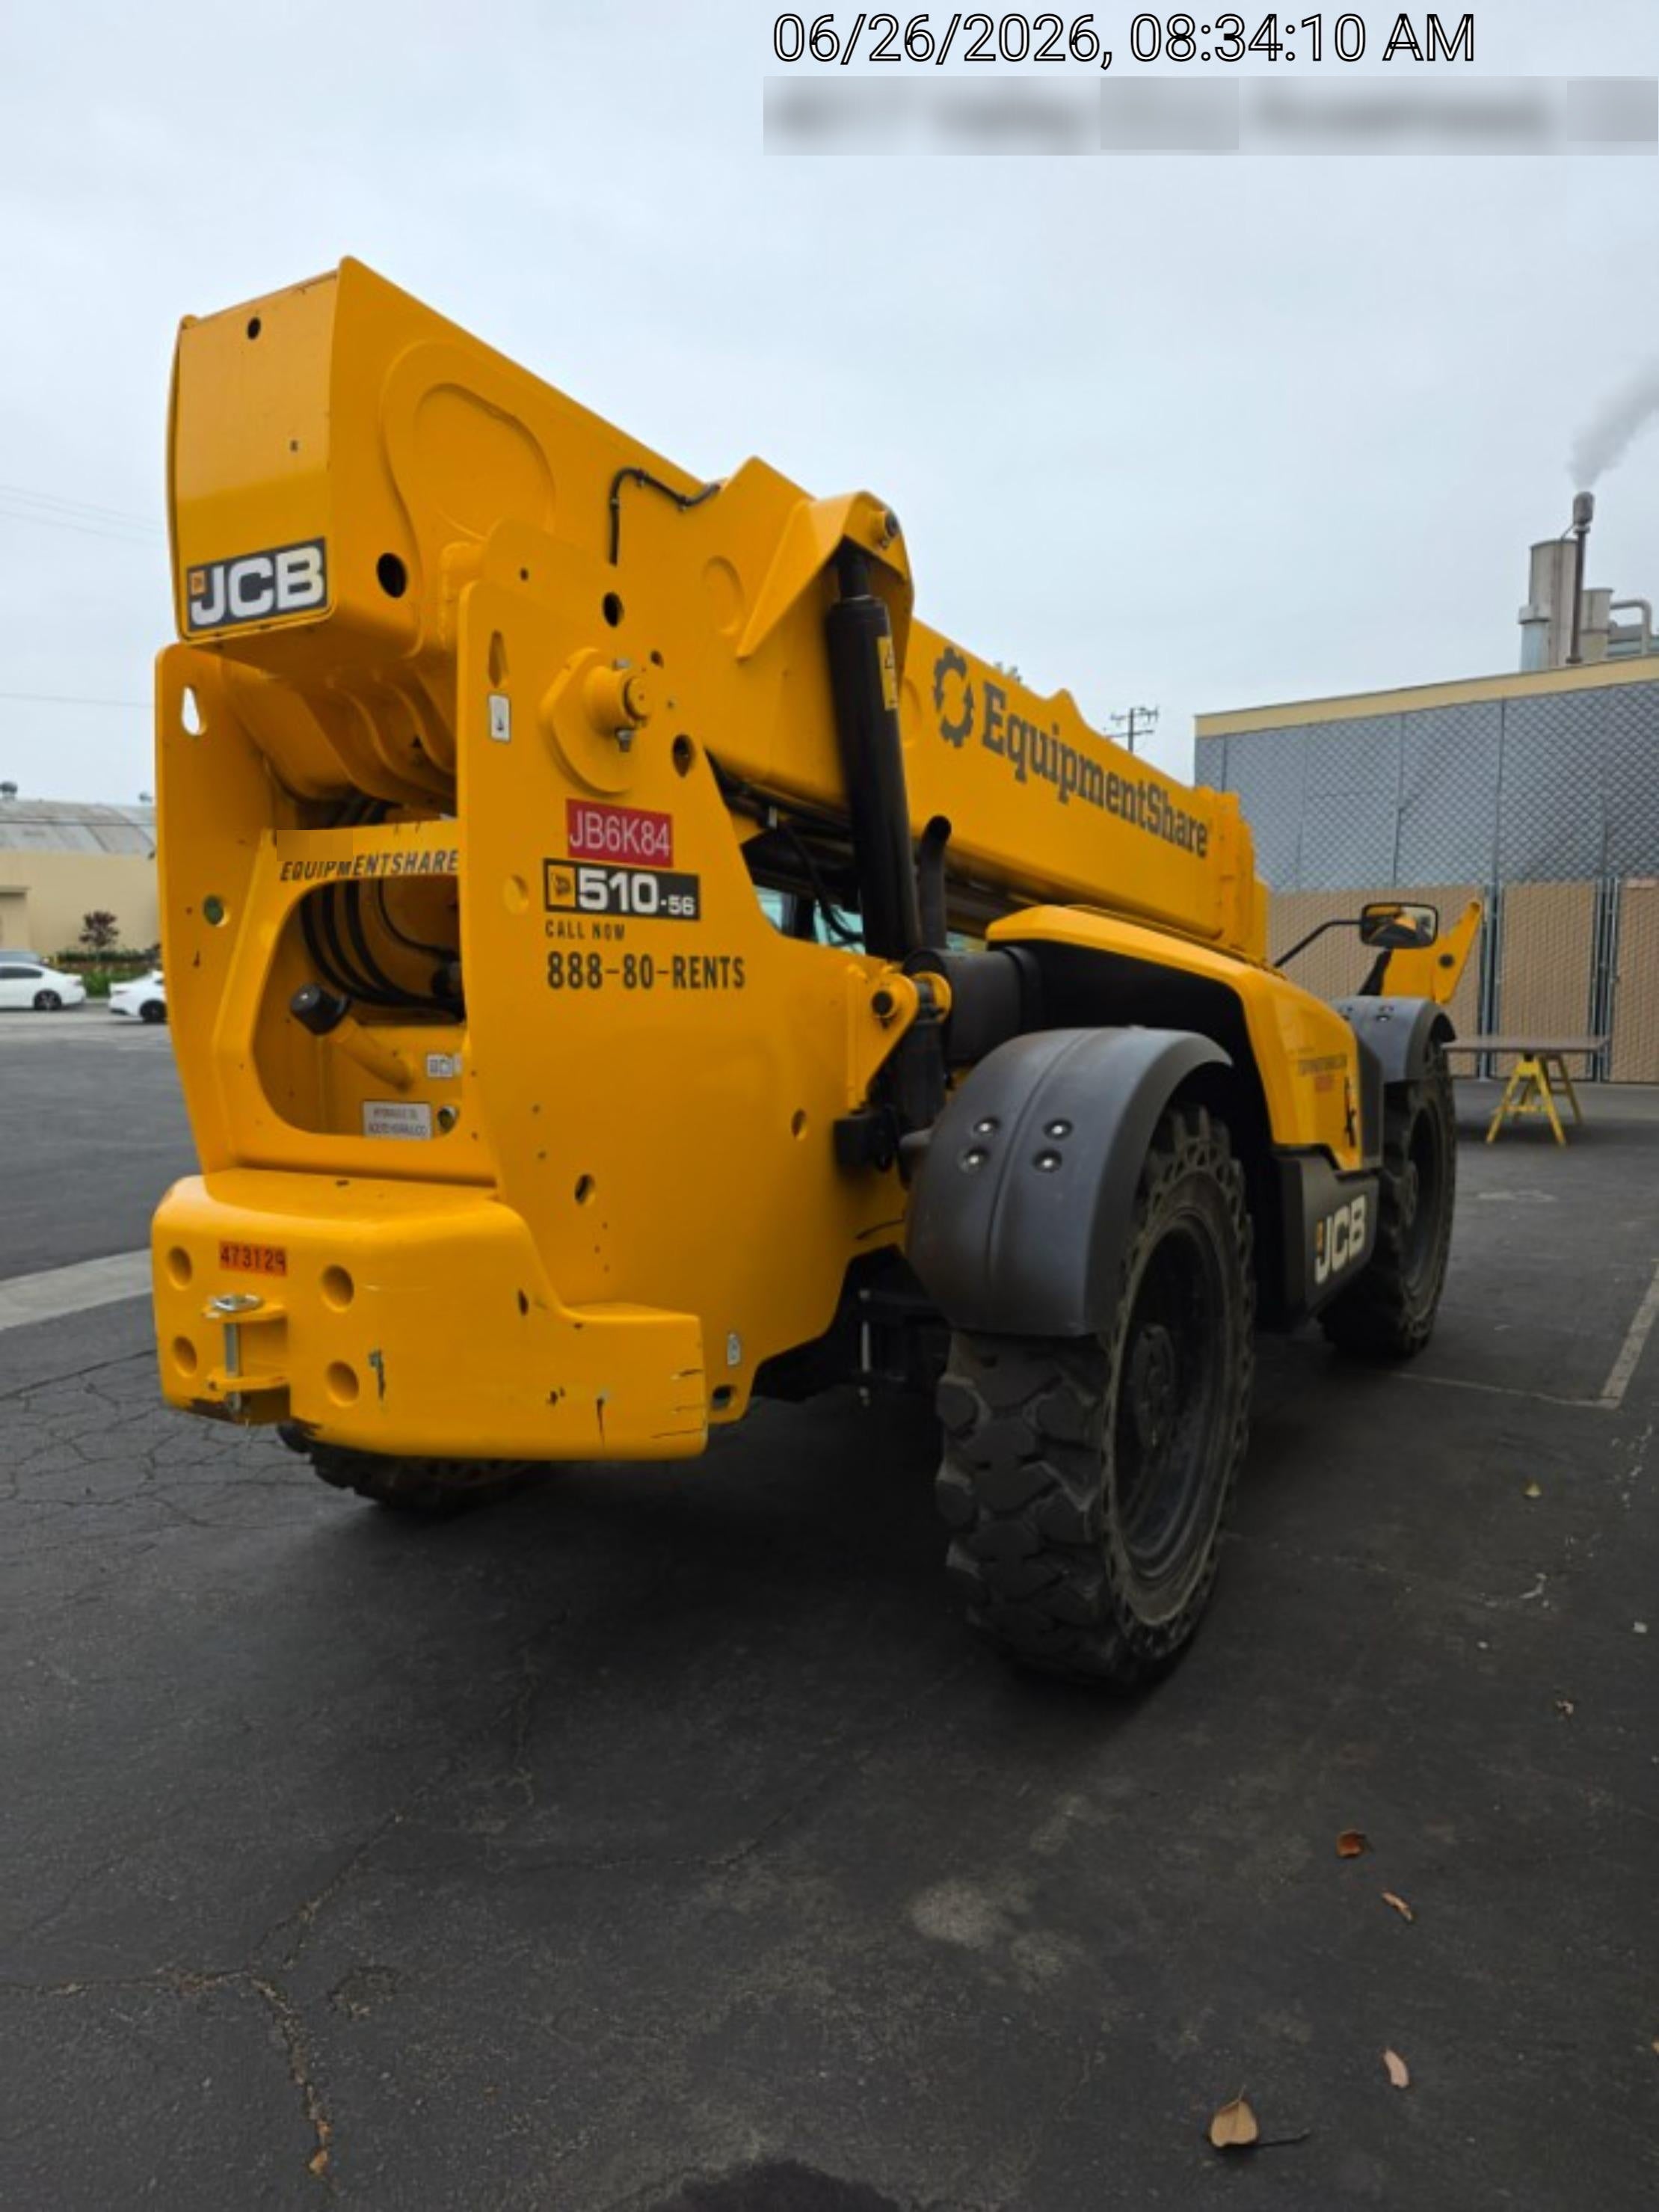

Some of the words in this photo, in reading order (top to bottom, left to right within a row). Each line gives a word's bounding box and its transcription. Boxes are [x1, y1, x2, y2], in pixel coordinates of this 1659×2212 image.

[189, 545, 325, 626] JCB
[981, 679, 1208, 859] EquipmentShare
[569, 809, 671, 858] JB6K84
[279, 849, 459, 882] EQUIPMENTSHARE
[545, 918, 585, 939] CALL
[591, 921, 625, 941] NOW
[547, 950, 746, 990] 888-80-RENTS
[221, 1243, 286, 1275] 473129
[1314, 1194, 1367, 1285] JCB
